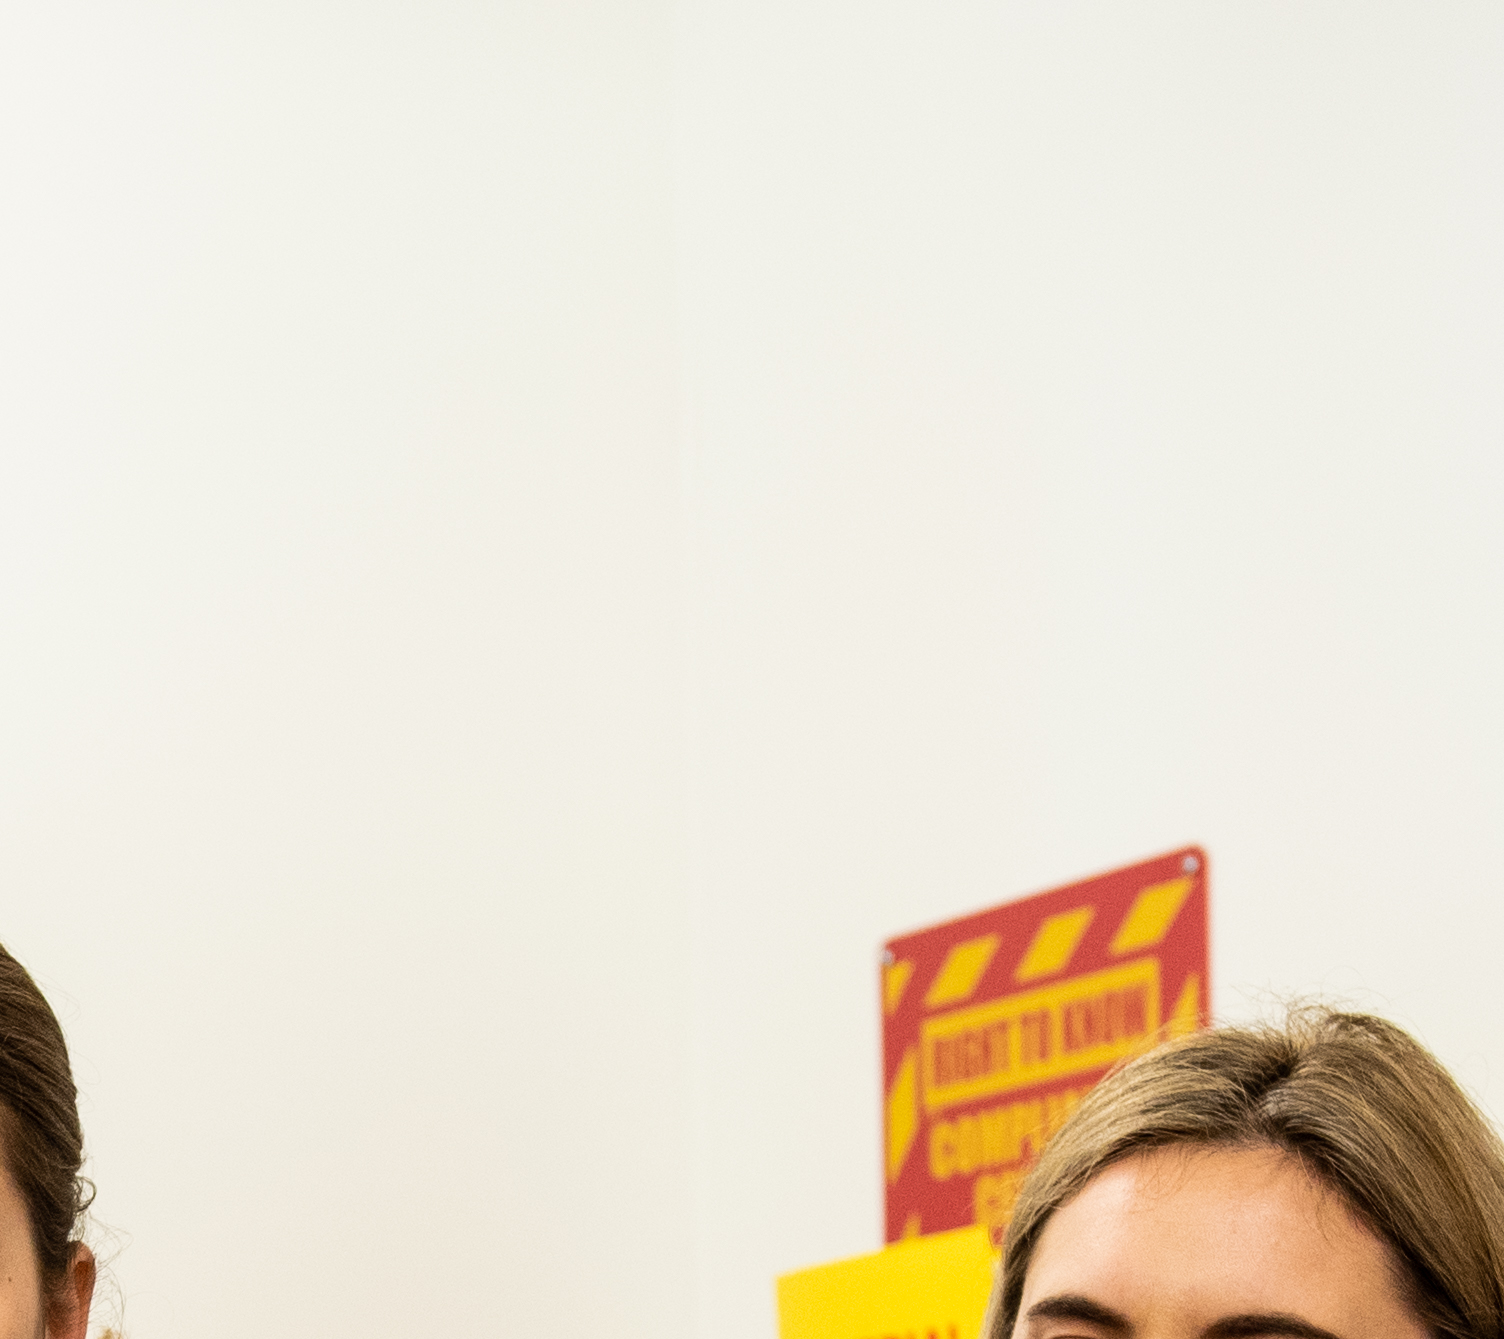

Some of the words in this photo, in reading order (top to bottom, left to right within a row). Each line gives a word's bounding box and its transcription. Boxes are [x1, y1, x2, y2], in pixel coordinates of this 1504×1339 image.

[932, 1019, 1011, 1085] RIGHT
[1020, 1005, 1052, 1063] TO
[1062, 980, 1150, 1055] KNOW
